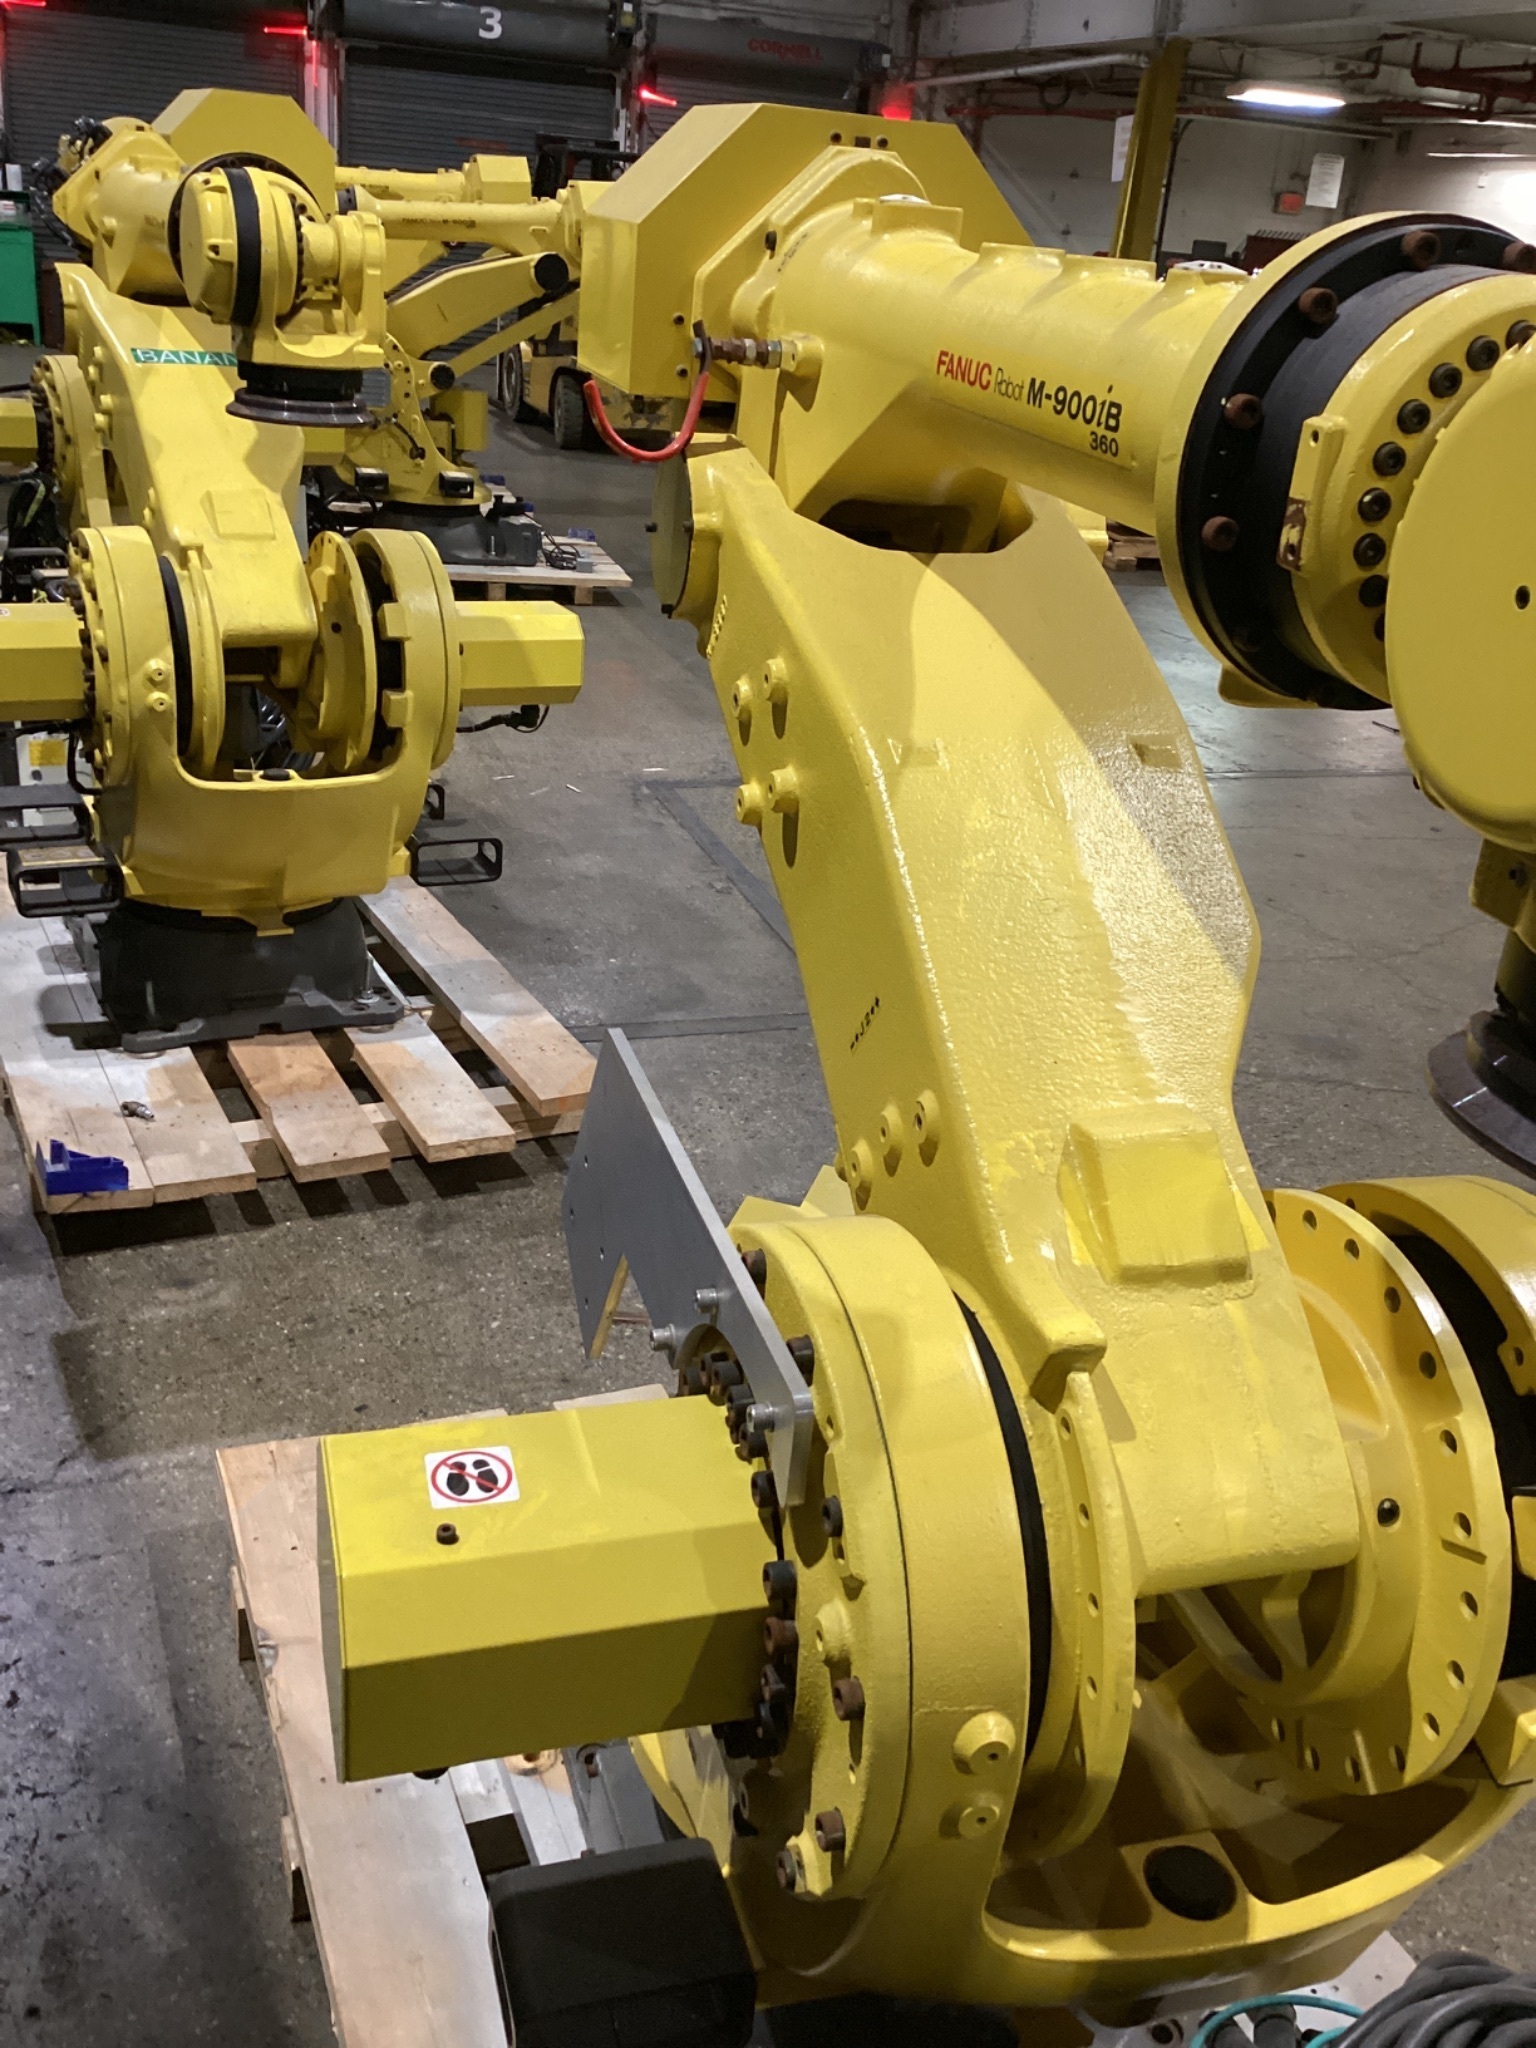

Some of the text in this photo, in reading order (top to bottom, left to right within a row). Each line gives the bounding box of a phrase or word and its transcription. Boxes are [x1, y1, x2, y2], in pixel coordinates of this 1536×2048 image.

[479, 6, 502, 39] 3
[936, 350, 1122, 433] FANUC Robot M-900iB
[1089, 431, 1119, 457] 360
